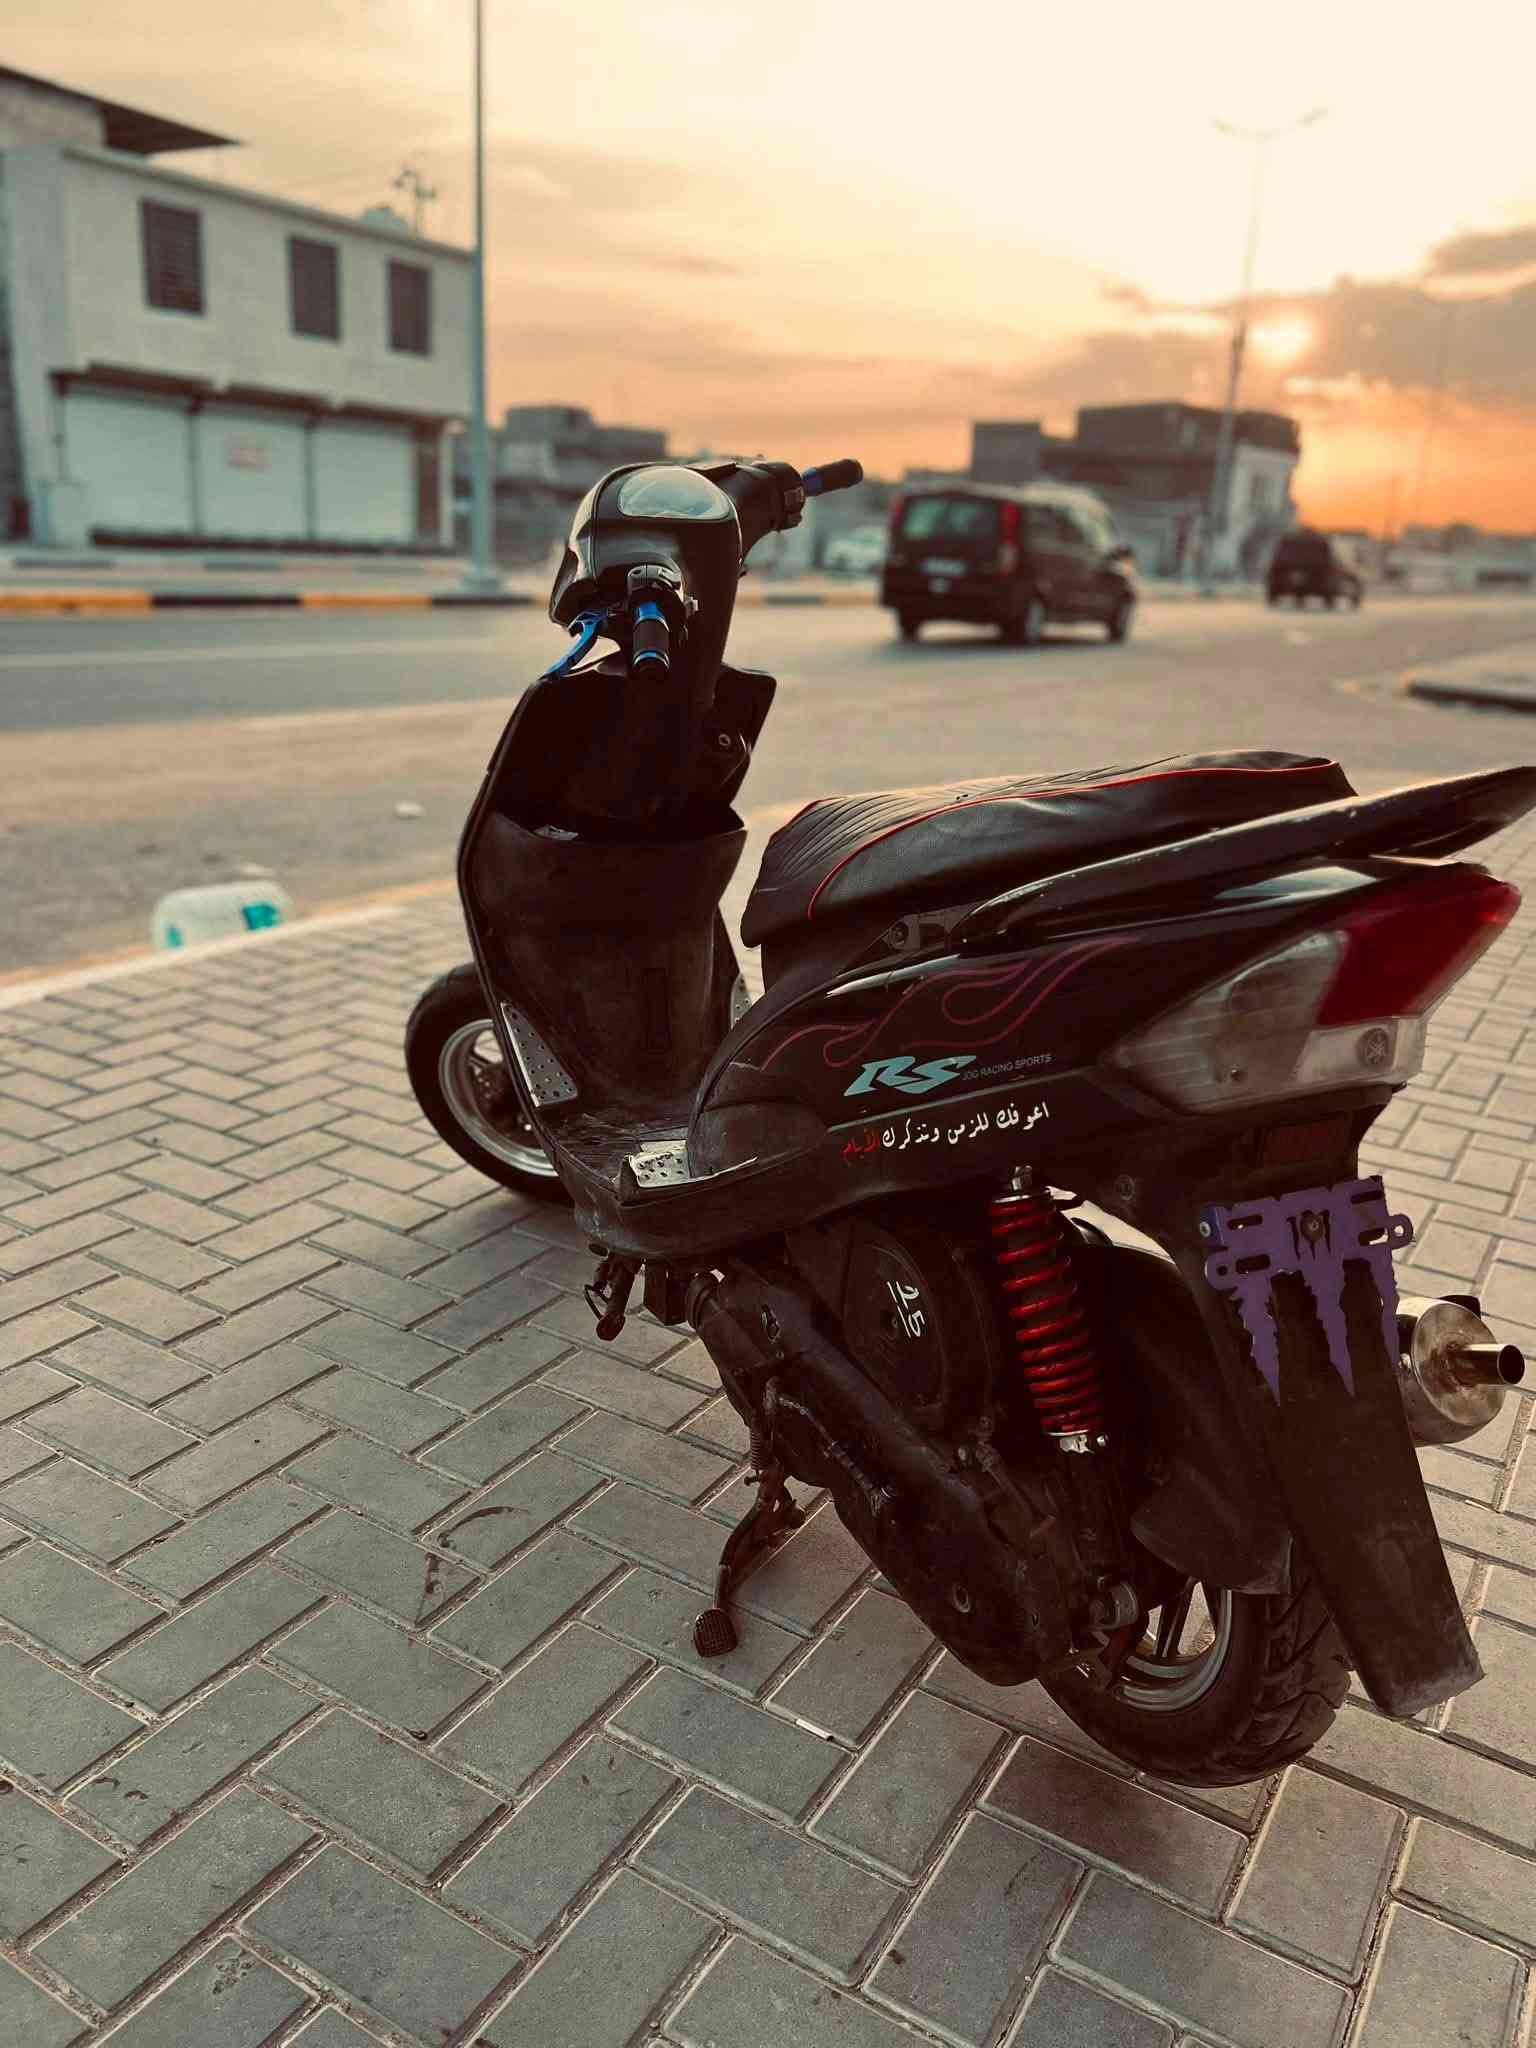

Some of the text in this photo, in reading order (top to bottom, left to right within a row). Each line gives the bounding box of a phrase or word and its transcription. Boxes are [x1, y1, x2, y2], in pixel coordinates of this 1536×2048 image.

[844, 1055, 977, 1097] RS
[980, 1061, 1013, 1079] RACING
[1014, 1053, 1052, 1071] SPORTS
